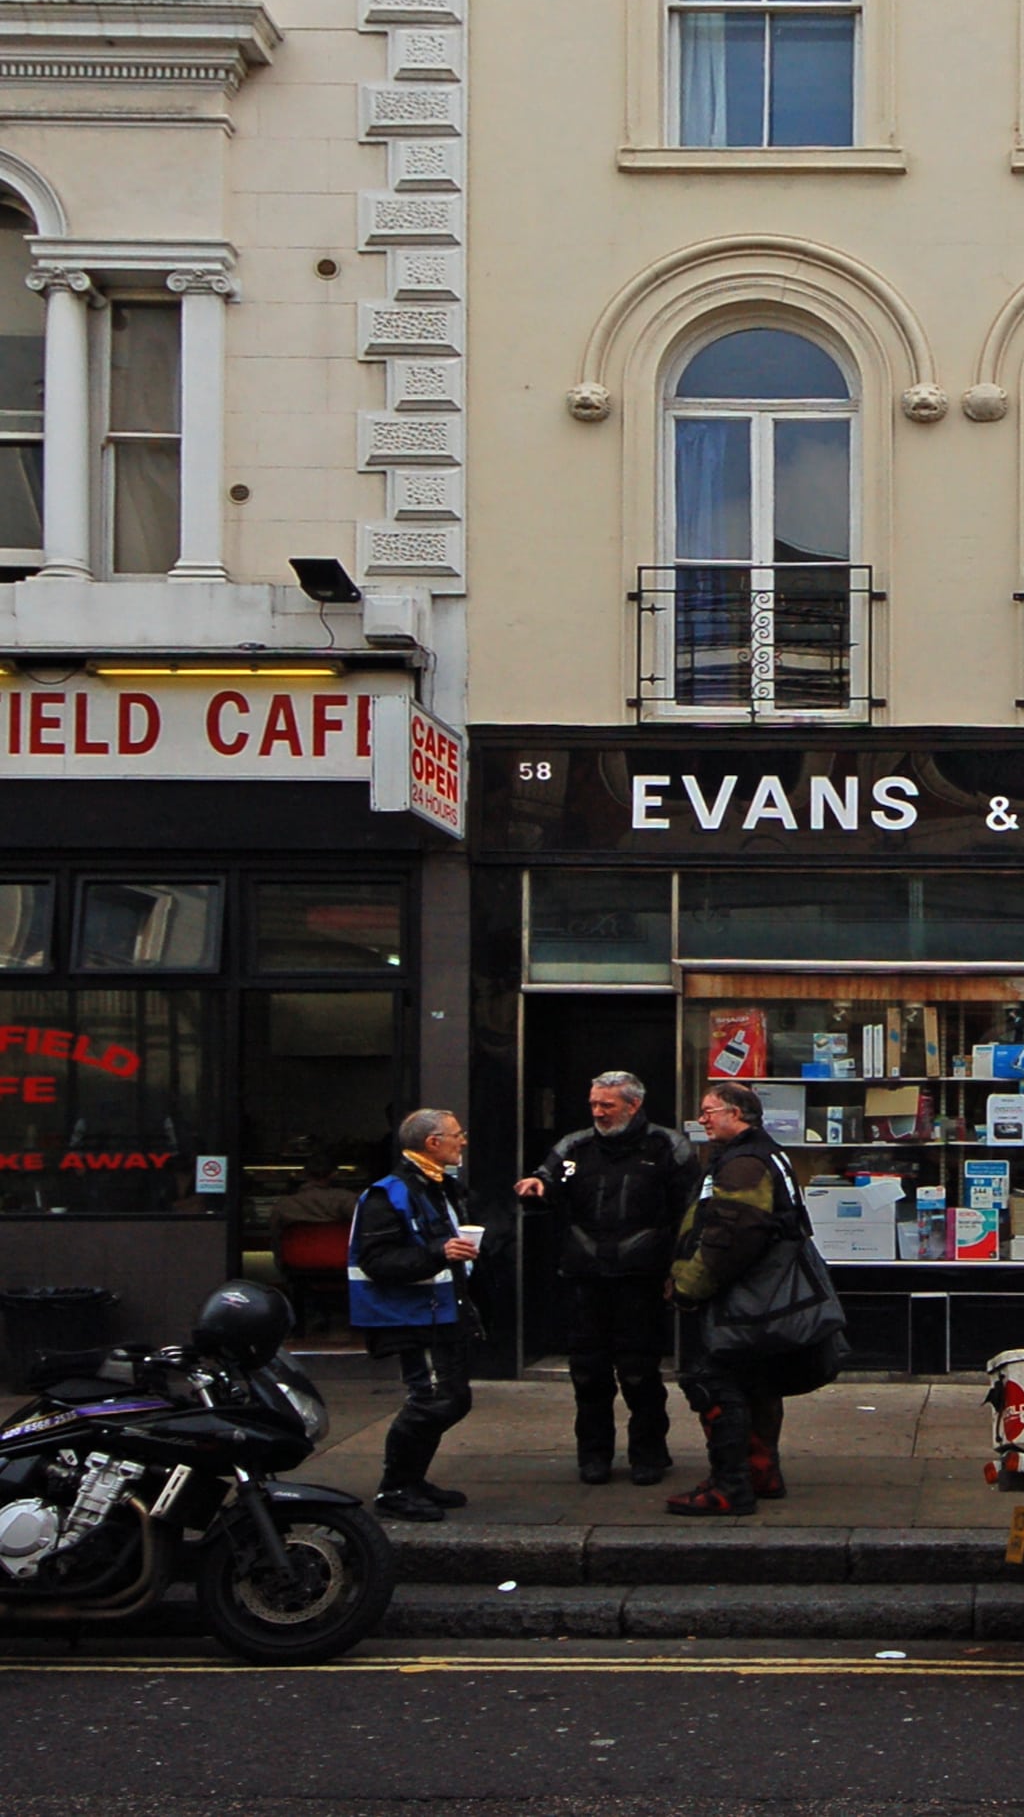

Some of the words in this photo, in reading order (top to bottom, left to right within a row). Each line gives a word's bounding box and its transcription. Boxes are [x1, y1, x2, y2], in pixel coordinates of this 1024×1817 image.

[0, 692, 160, 755] IELD
[412, 715, 459, 773] CAFE
[411, 748, 458, 804] OPEN
[519, 762, 552, 780] 58
[412, 783, 424, 805] 24
[426, 791, 458, 827] HOURS
[632, 775, 919, 830] EVANS
[985, 796, 1019, 831] &
[59, 1153, 170, 1170] AWAY
